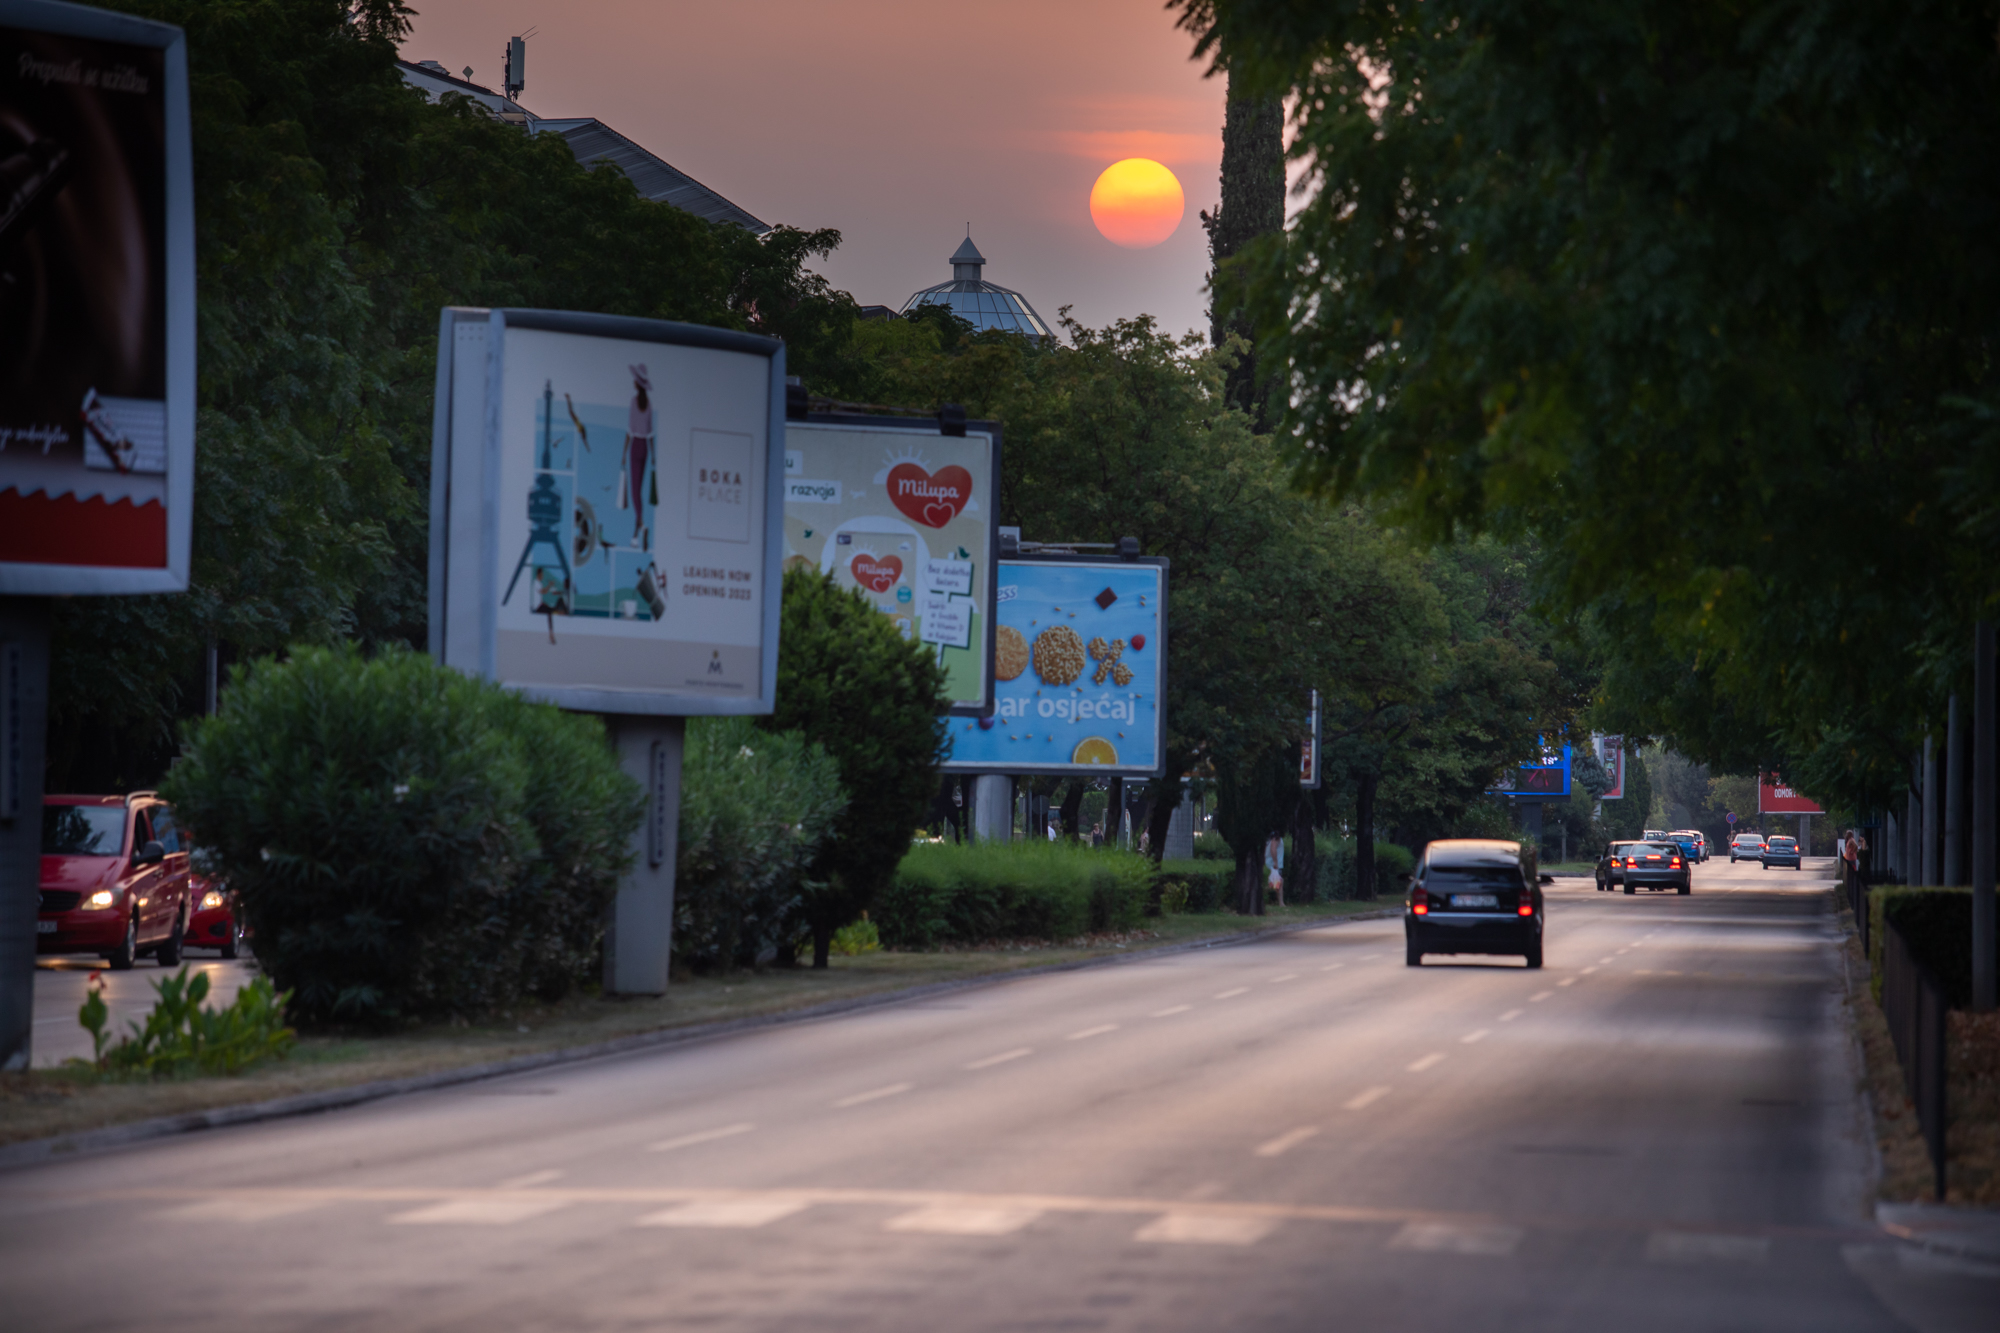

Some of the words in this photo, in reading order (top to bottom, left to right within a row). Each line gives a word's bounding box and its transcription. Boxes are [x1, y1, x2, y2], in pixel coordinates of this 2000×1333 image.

[698, 468, 743, 485] BOKA
[698, 486, 743, 505] PLACE
[791, 483, 836, 501] razvoja
[898, 478, 961, 505] Milupa
[683, 566, 725, 580] LEASING
[728, 570, 752, 582] NOW
[857, 563, 896, 578] Milupa
[683, 584, 726, 598] OPENING
[1037, 691, 1136, 726] osjećaj
